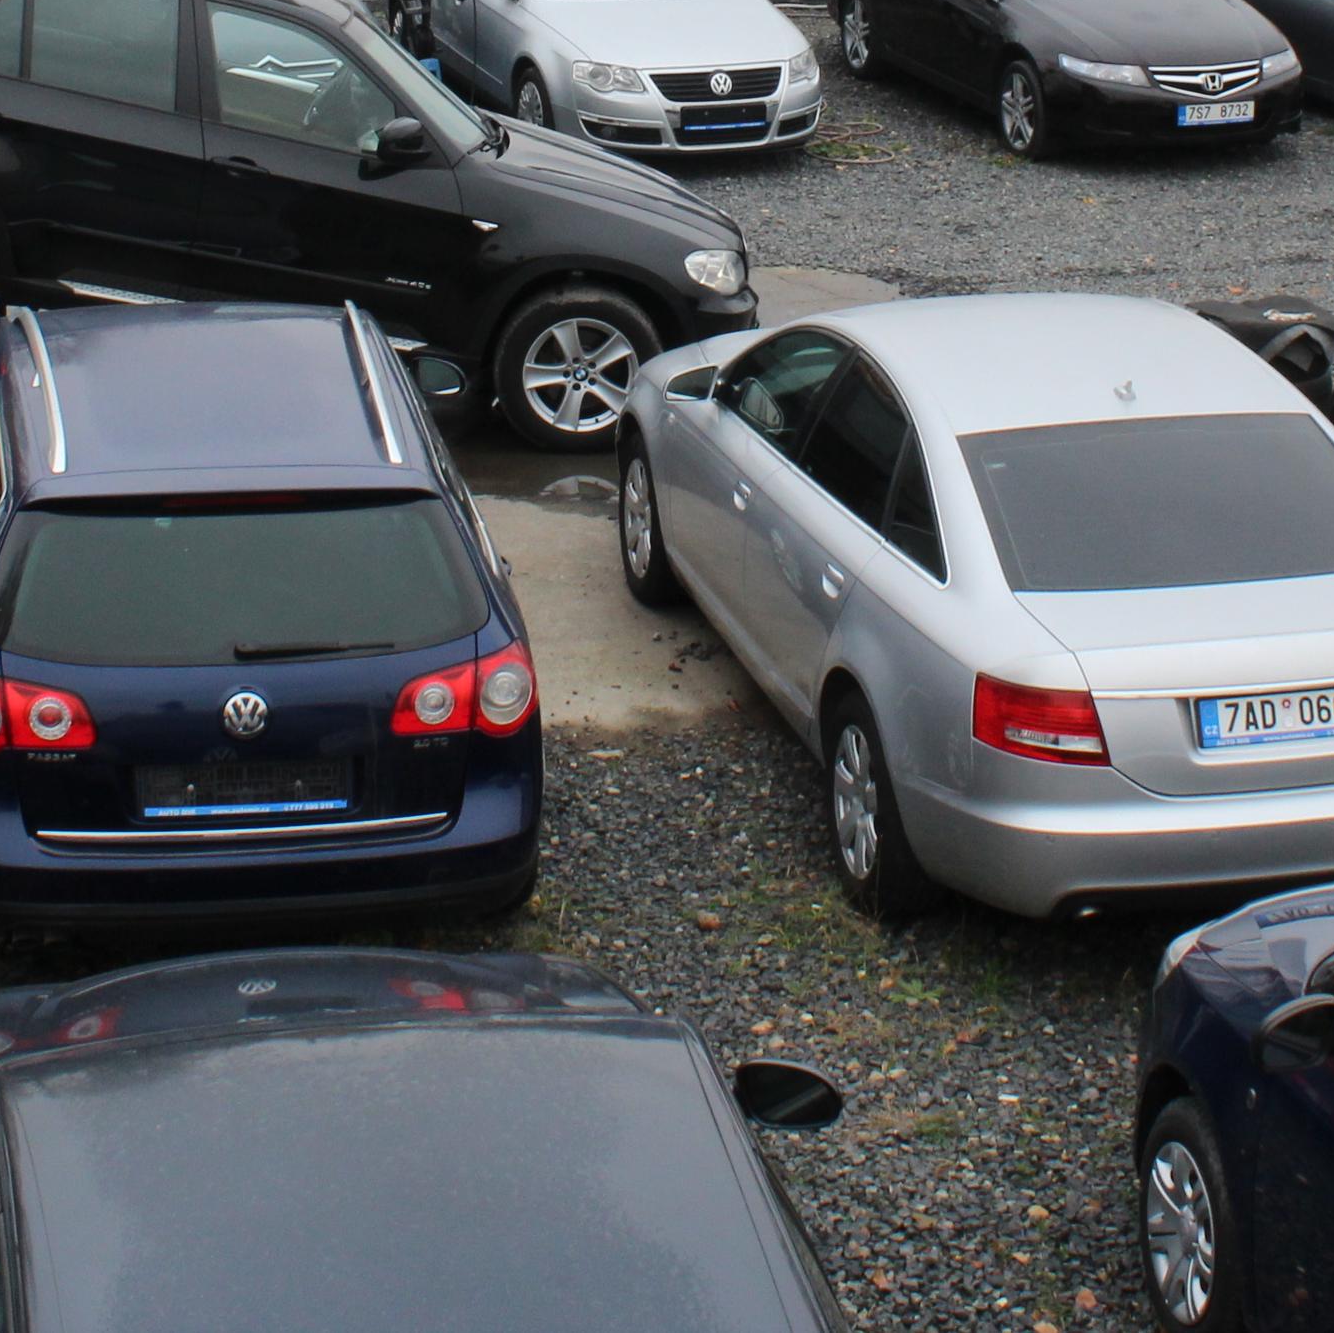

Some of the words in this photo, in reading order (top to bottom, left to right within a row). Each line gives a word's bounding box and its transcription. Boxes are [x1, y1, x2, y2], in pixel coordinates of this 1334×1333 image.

[1188, 105, 1211, 120] 7S7
[1219, 103, 1249, 118] 8732
[1224, 699, 1277, 733] 7AD
[1204, 724, 1218, 735] CZ
